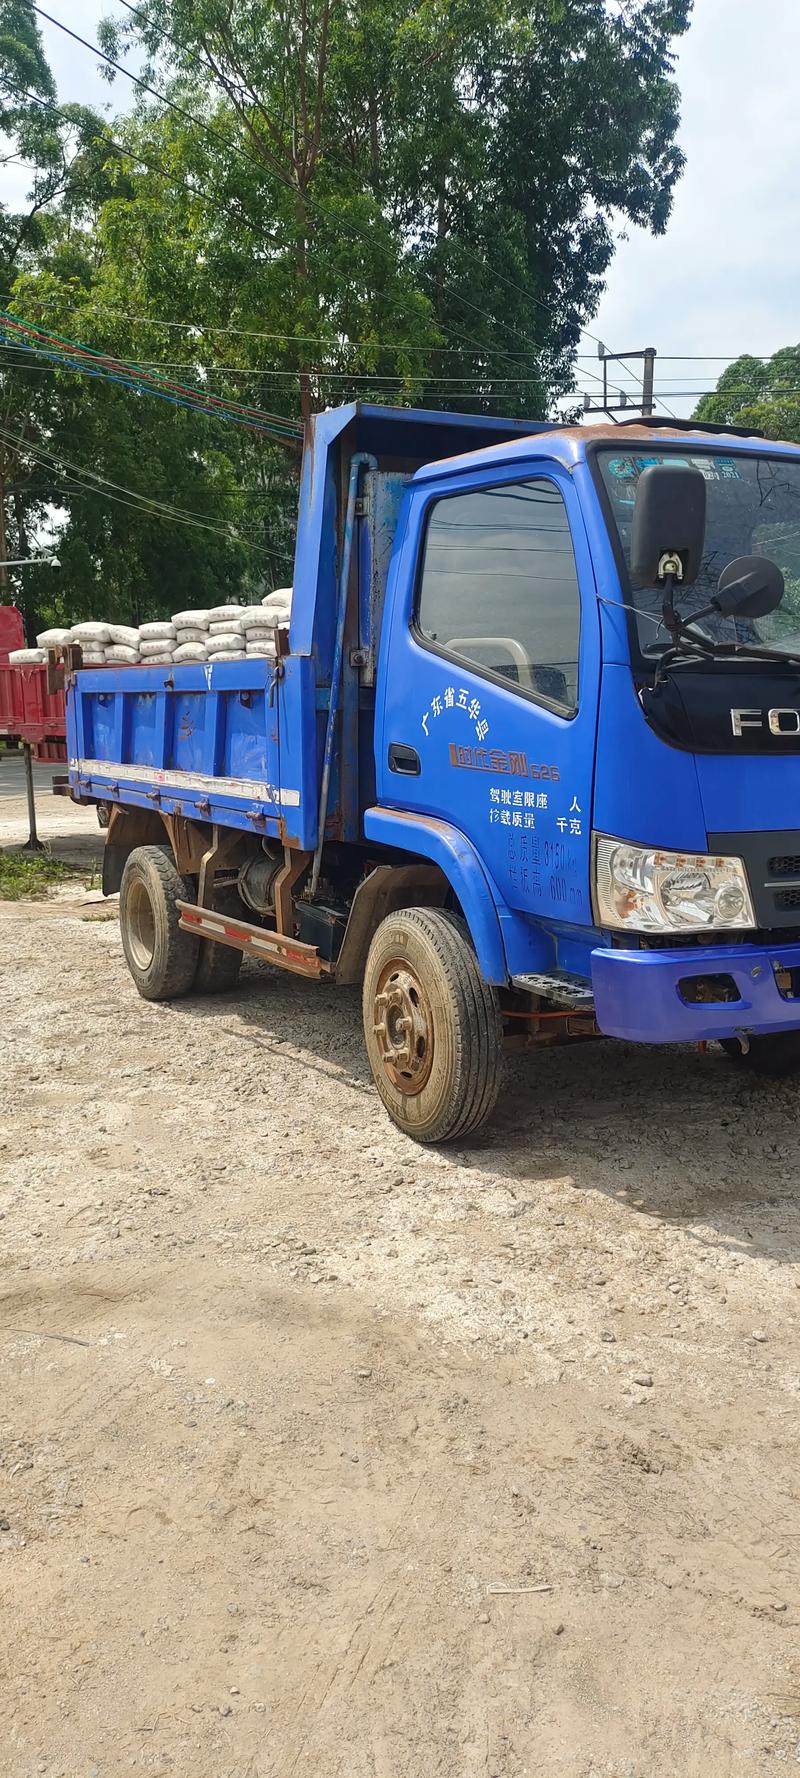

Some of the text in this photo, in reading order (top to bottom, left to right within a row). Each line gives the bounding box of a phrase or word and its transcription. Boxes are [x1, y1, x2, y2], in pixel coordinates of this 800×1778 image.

[722, 471, 740, 479] 2021
[421, 687, 489, 741] 广东省五华县
[489, 787, 582, 813] 驾驶室限座 人
[556, 817, 582, 835] 千克
